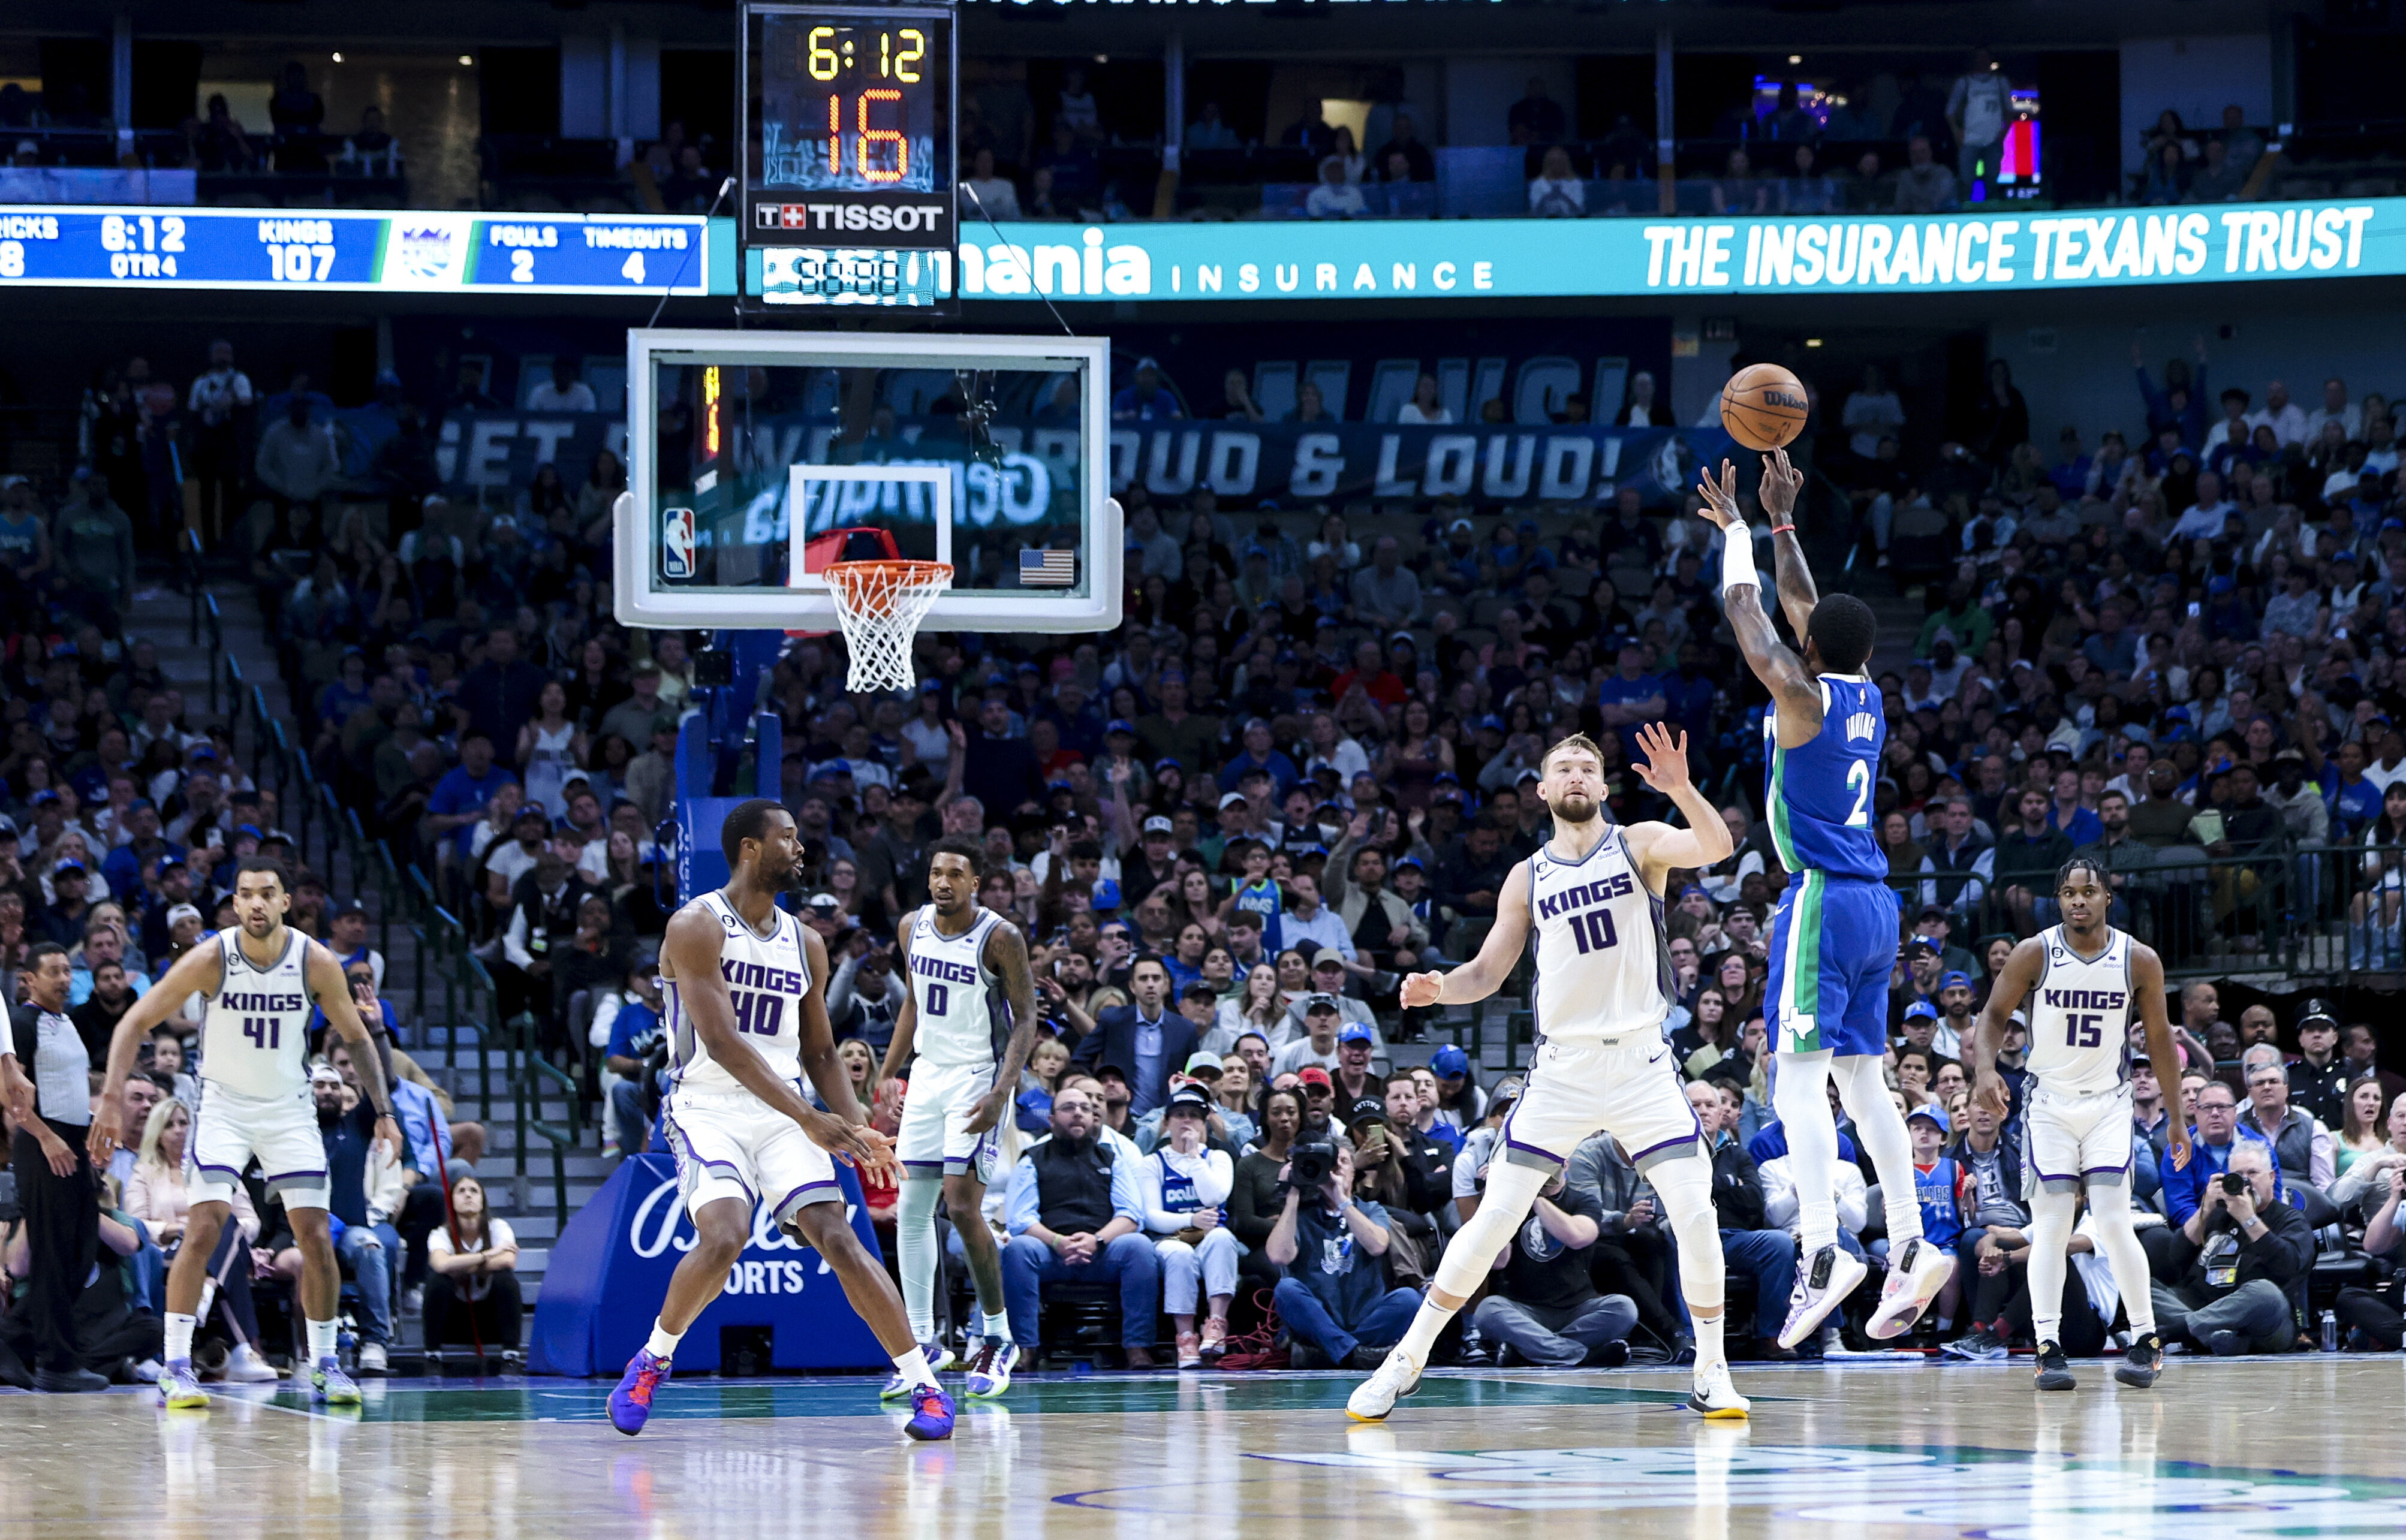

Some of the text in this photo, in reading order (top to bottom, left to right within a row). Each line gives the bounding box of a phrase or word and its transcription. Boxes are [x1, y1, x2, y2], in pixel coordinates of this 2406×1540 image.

[808, 26, 925, 83] 6:12
[829, 89, 908, 182] 16
[0, 216, 59, 239] ICKS
[101, 215, 186, 251] 6:12
[258, 219, 333, 244] KINGS
[809, 204, 944, 231] TISSOT
[490, 225, 558, 248] FOULS
[583, 226, 688, 249] TIMEOUTS
[1643, 206, 2375, 287] THE INSURANCE TEXANS TRUST
[267, 243, 335, 281] 107
[511, 249, 534, 282] 2
[621, 251, 646, 284] 4
[1172, 260, 1494, 293] INSURANCE
[1764, 390, 1808, 412] Wilson
[1288, 432, 1345, 498] &
[1372, 435, 1624, 502] LOUD!
[1846, 712, 1876, 742] IRVING
[1844, 759, 1870, 829] 2
[1597, 849, 1621, 860] dialpad
[1538, 872, 1634, 921] KINGS
[1568, 908, 1618, 955] 10
[721, 958, 802, 995] KINGS
[910, 953, 977, 986] KINGS
[222, 992, 302, 1012] KINGS
[731, 991, 784, 1036] 40
[927, 984, 948, 1017] 0
[2044, 989, 2125, 1010] KINGS
[243, 1017, 280, 1049] 41
[2065, 1013, 2101, 1048] 15
[1916, 1184, 1950, 1201] ALLAS
[723, 1260, 804, 1295] ORTS
